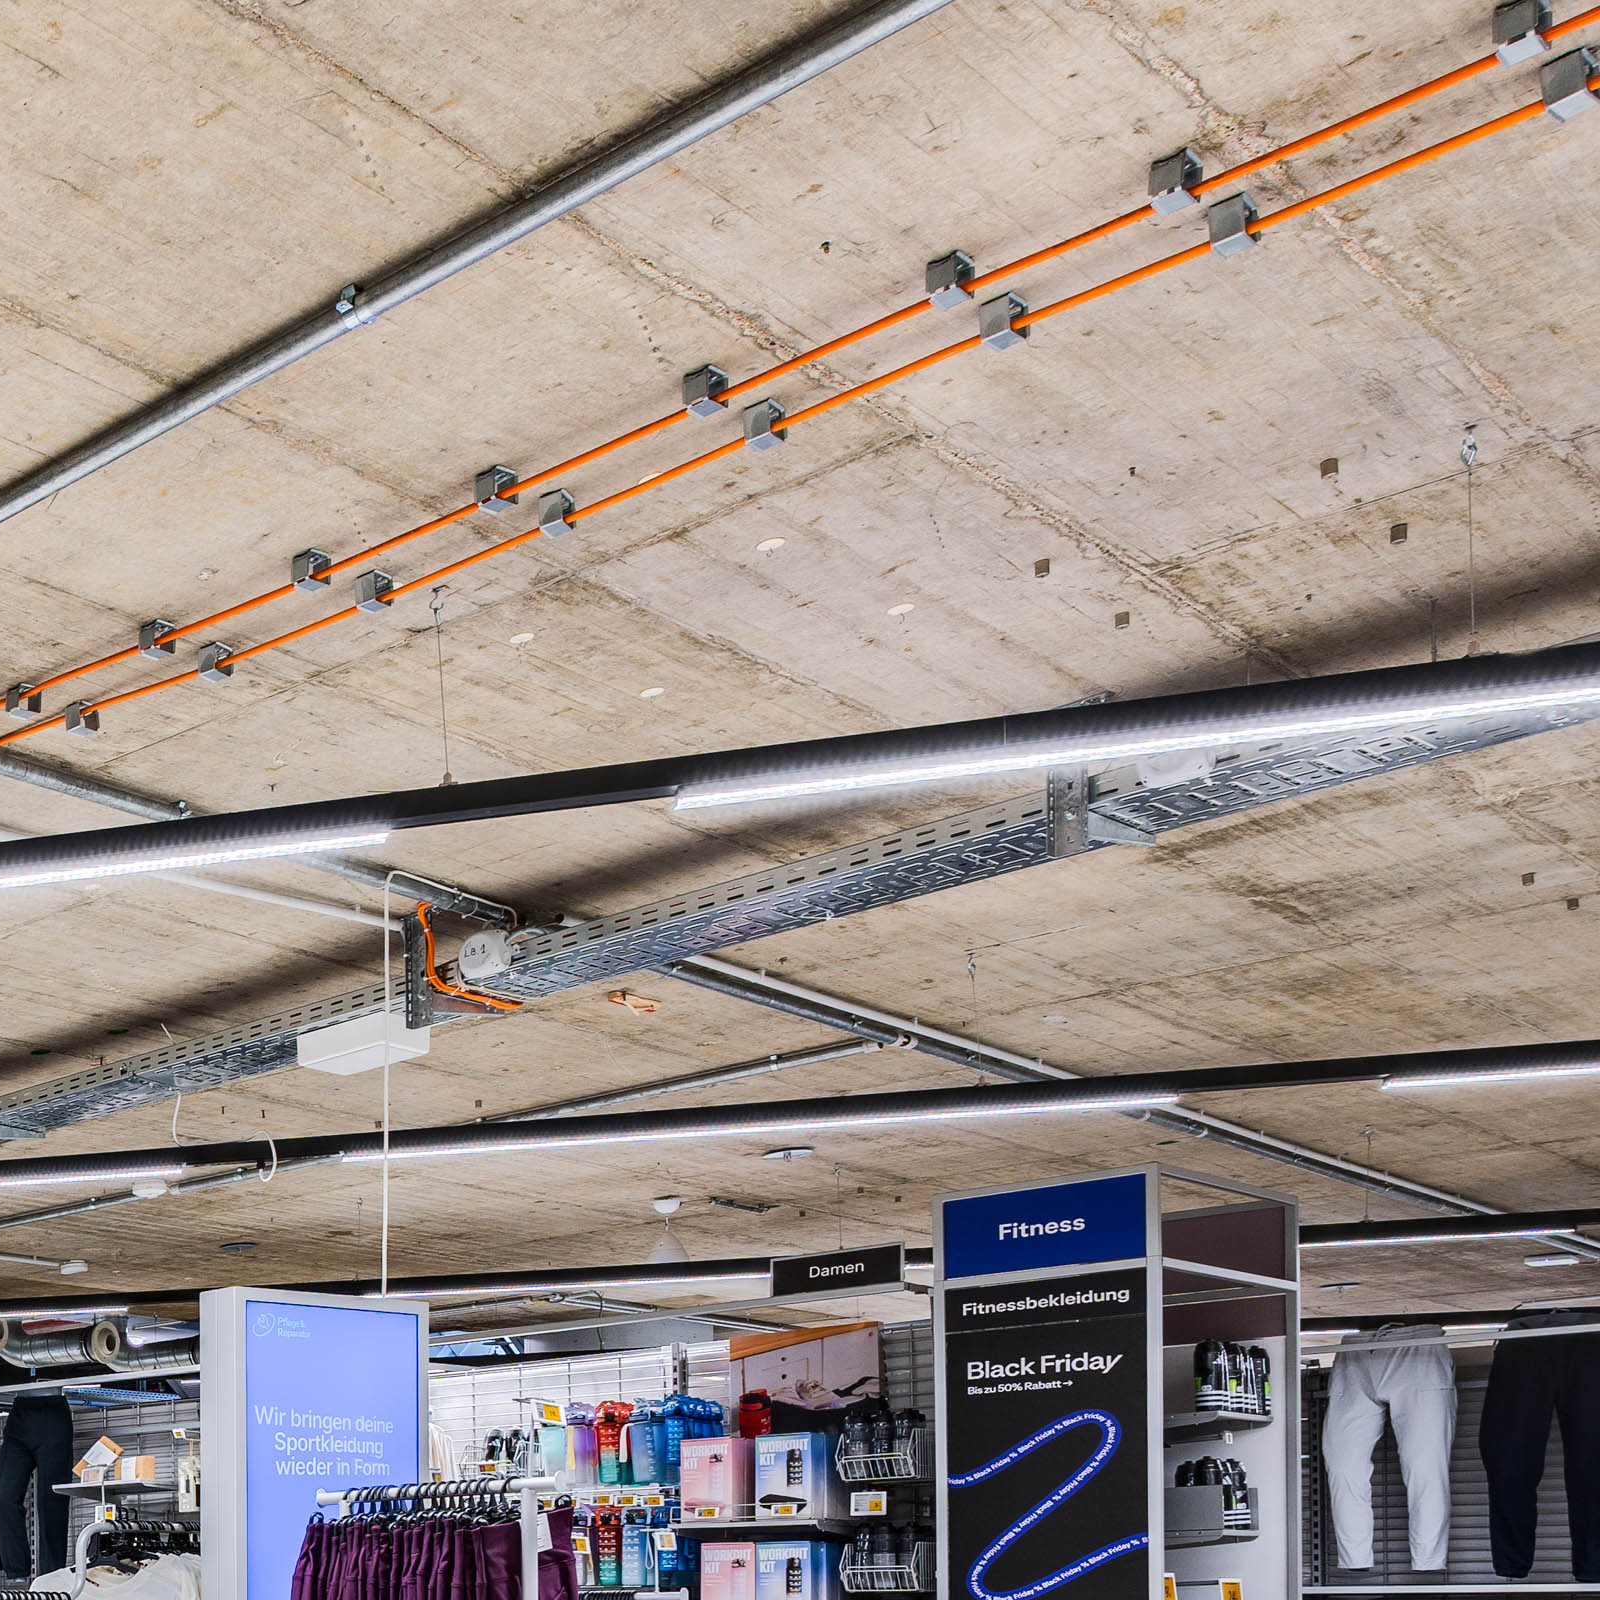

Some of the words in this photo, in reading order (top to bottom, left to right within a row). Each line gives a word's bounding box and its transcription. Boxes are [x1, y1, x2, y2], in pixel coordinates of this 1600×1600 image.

[998, 1217, 1086, 1241] Fitness
[809, 1262, 865, 1279] Damen
[962, 1288, 1130, 1317] Fitnessbekleidung
[967, 1357, 1036, 1381] Black
[1040, 1351, 1124, 1375] Friday
[967, 1385, 983, 1396] Bis
[984, 1384, 996, 1394] zu
[998, 1382, 1023, 1393] 50%
[1024, 1379, 1063, 1391] Rabatt
[254, 1405, 286, 1427] Wir
[291, 1408, 352, 1434] bringen
[355, 1415, 394, 1434] deine
[1062, 1414, 1084, 1427] Black
[1083, 1412, 1106, 1423] Friday
[1035, 1427, 1056, 1444] Friday
[274, 1432, 384, 1459] Sportkleidung
[682, 1443, 729, 1457] WORKOUT
[758, 1438, 809, 1452] WORKOUT
[1017, 1439, 1036, 1453] Black
[683, 1457, 698, 1471] KIT
[759, 1452, 776, 1466] KIT
[990, 1456, 1011, 1471] Friday
[276, 1456, 333, 1476] wieder
[337, 1457, 350, 1476] in
[354, 1458, 391, 1477] Form
[973, 1467, 993, 1480] Black
[704, 1549, 752, 1562] WORKOUT
[758, 1547, 809, 1561] WORKOUT
[1107, 1541, 1131, 1556] Friday
[1088, 1552, 1109, 1565] Black
[704, 1561, 721, 1574] KIT
[759, 1560, 776, 1574] KIT
[1060, 1565, 1082, 1580] Friday
[1041, 1575, 1062, 1589] Black
[1013, 1588, 1035, 1600] Friday
